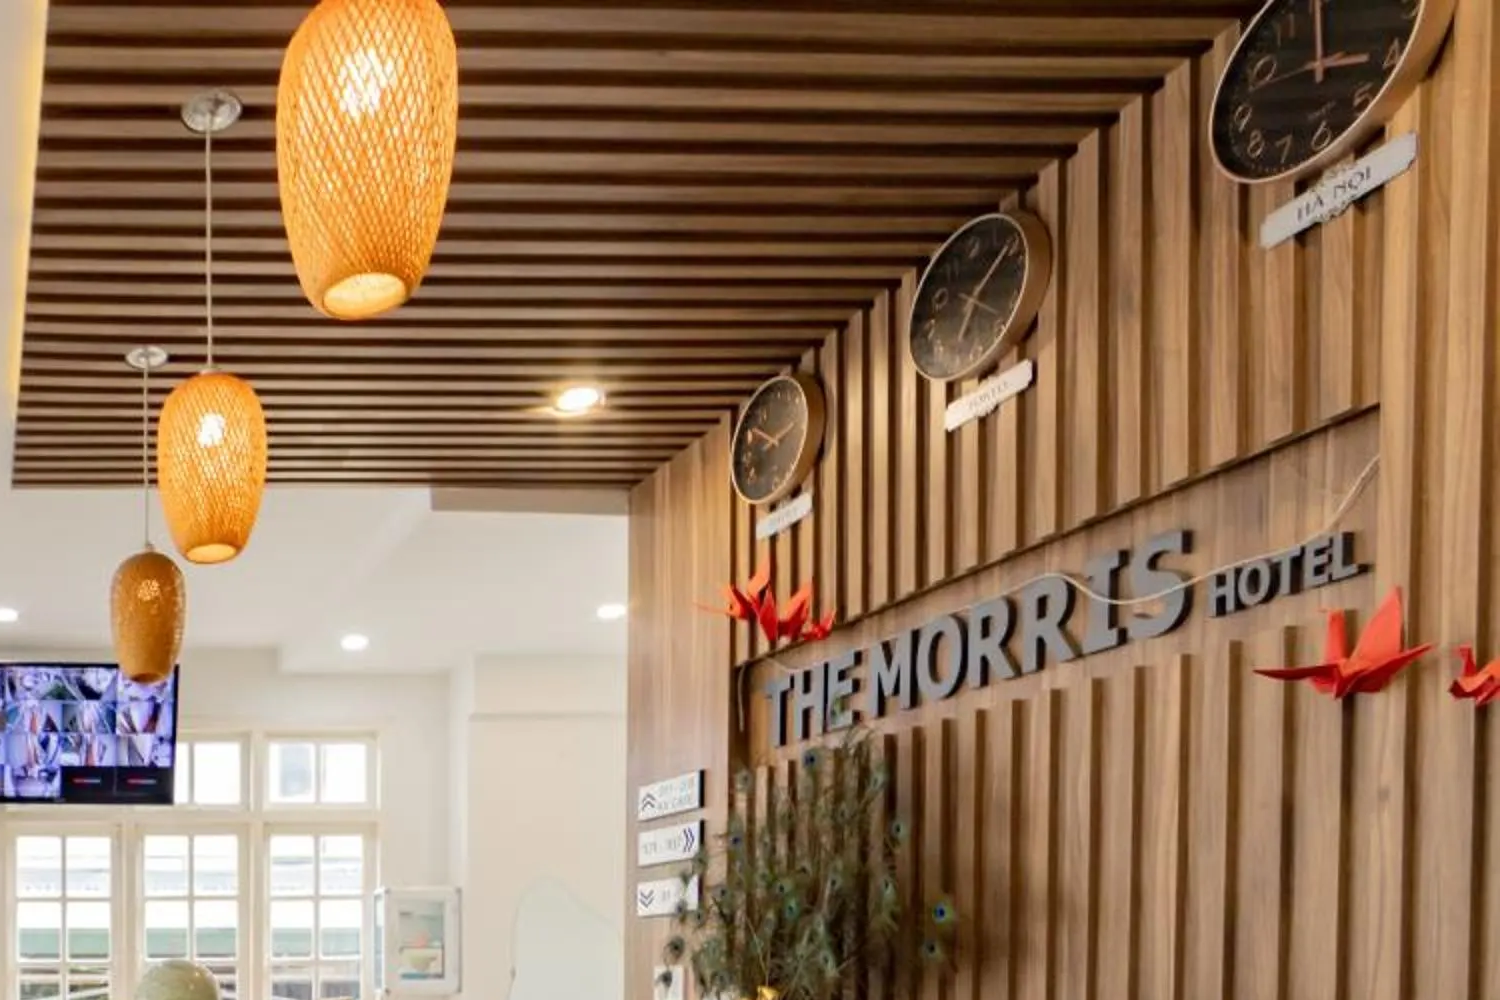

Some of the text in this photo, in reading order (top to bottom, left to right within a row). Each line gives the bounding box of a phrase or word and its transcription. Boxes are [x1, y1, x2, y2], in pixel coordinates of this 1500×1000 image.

[767, 529, 1368, 748] THE MORRIS HOTEL
